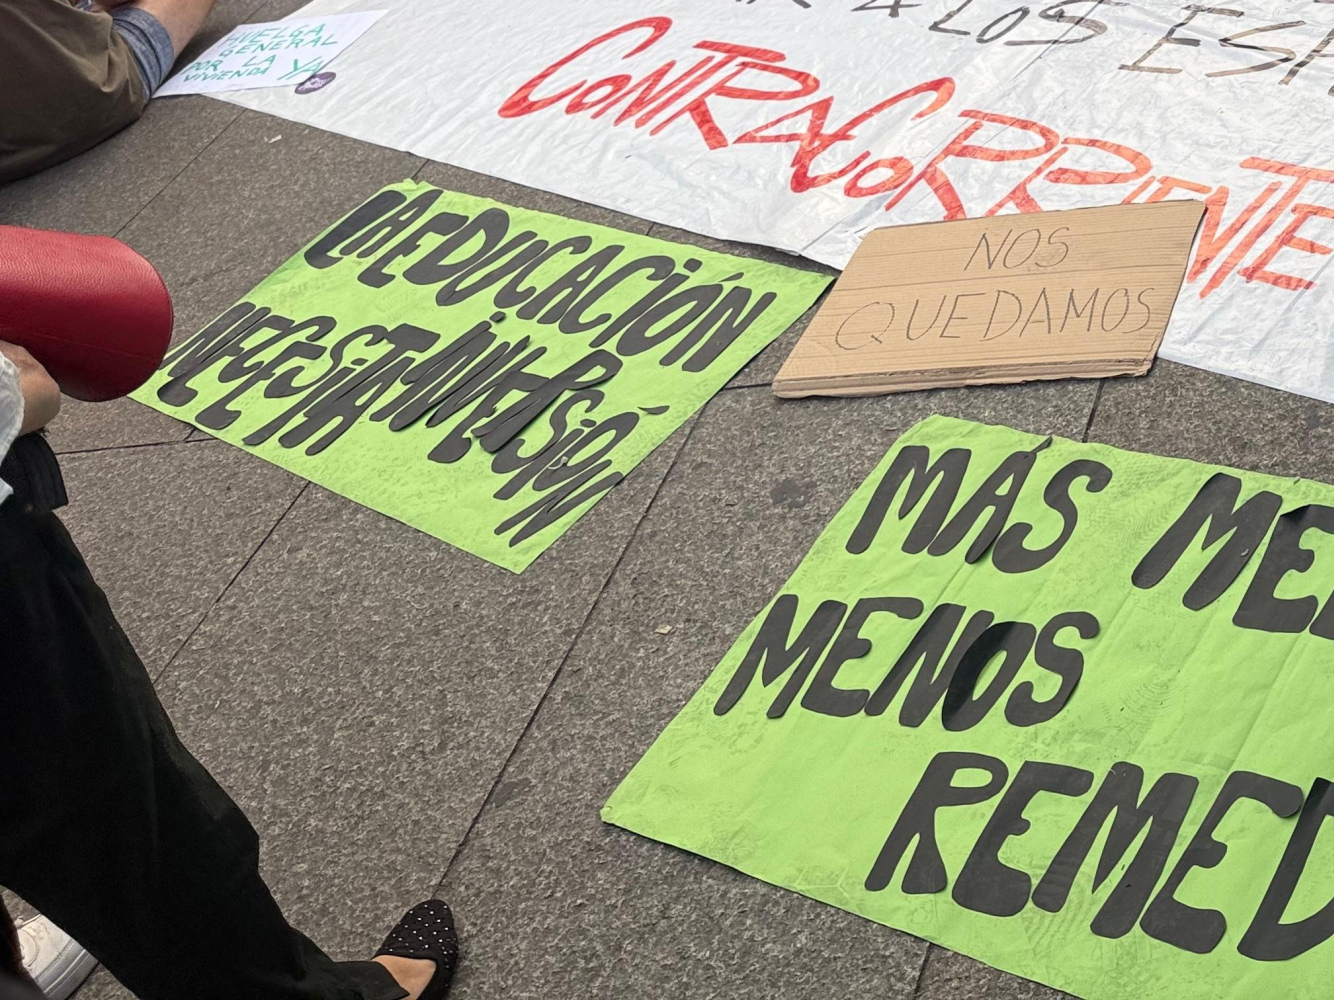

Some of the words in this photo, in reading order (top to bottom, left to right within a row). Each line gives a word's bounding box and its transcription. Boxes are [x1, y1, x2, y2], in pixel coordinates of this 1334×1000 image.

[218, 34, 338, 58] GENERAL
[219, 24, 326, 47] HUELGA
[181, 59, 223, 75] POR
[242, 55, 277, 67] LA
[276, 56, 324, 81] YA
[303, 189, 444, 269] LA
[964, 226, 1070, 273] NOS
[835, 286, 1156, 351] QUEDAMOS
[845, 436, 1113, 574] MÁS
[713, 594, 1101, 732] MENOS
